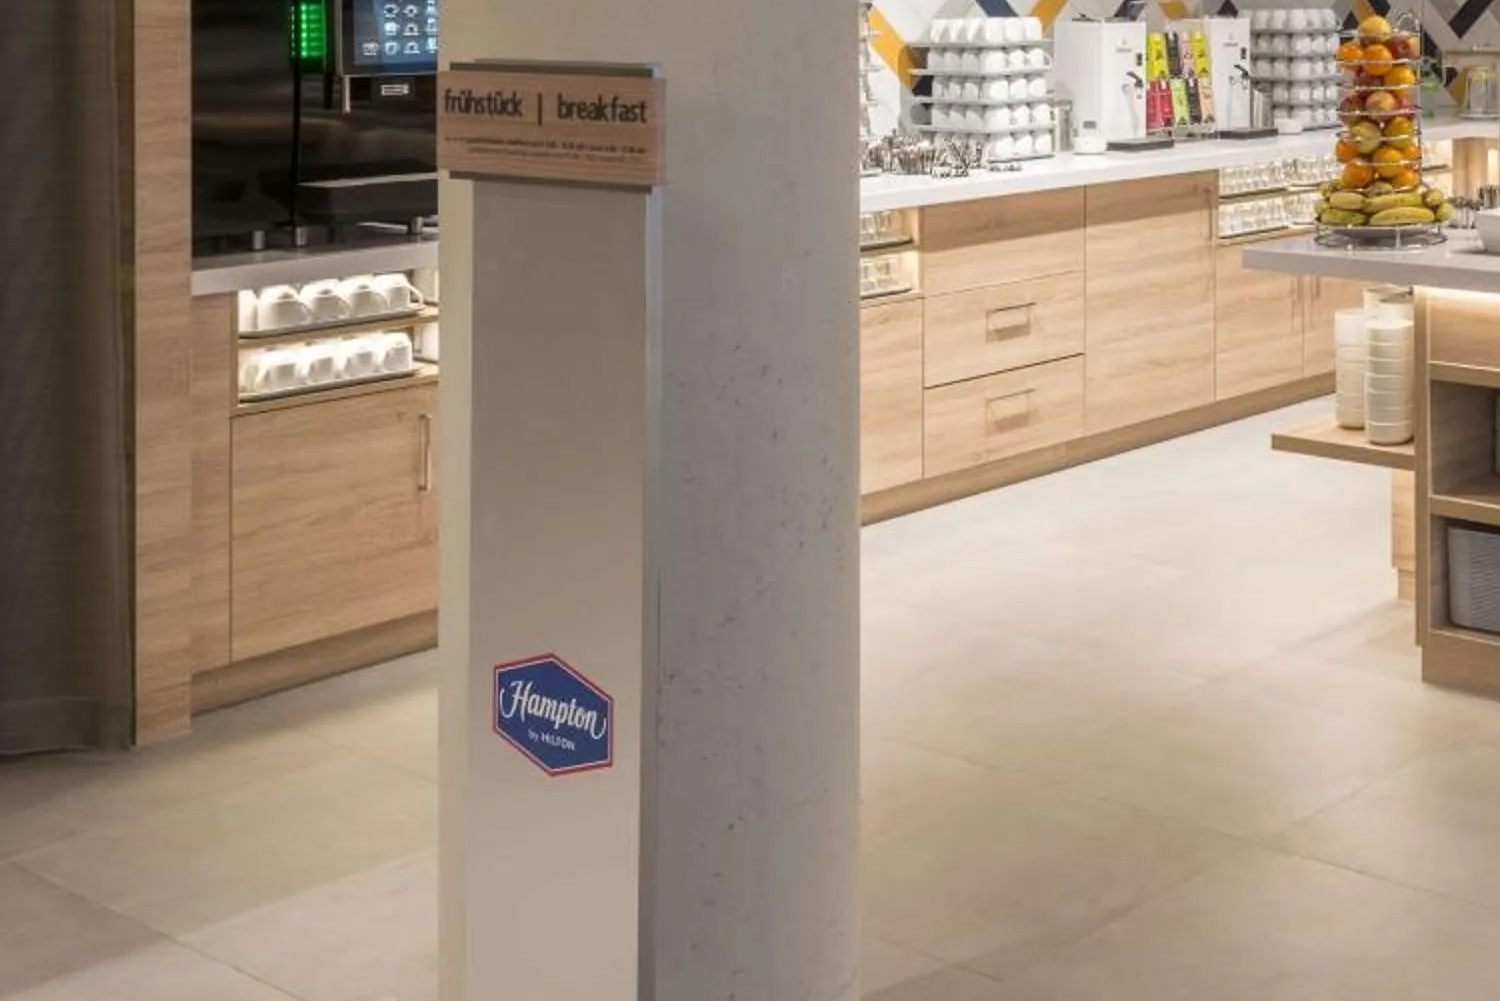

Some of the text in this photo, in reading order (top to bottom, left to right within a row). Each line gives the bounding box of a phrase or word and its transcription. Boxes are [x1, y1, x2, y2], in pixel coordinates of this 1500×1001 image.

[443, 86, 648, 124] frühstück breakfast
[499, 680, 607, 740] Hampton
